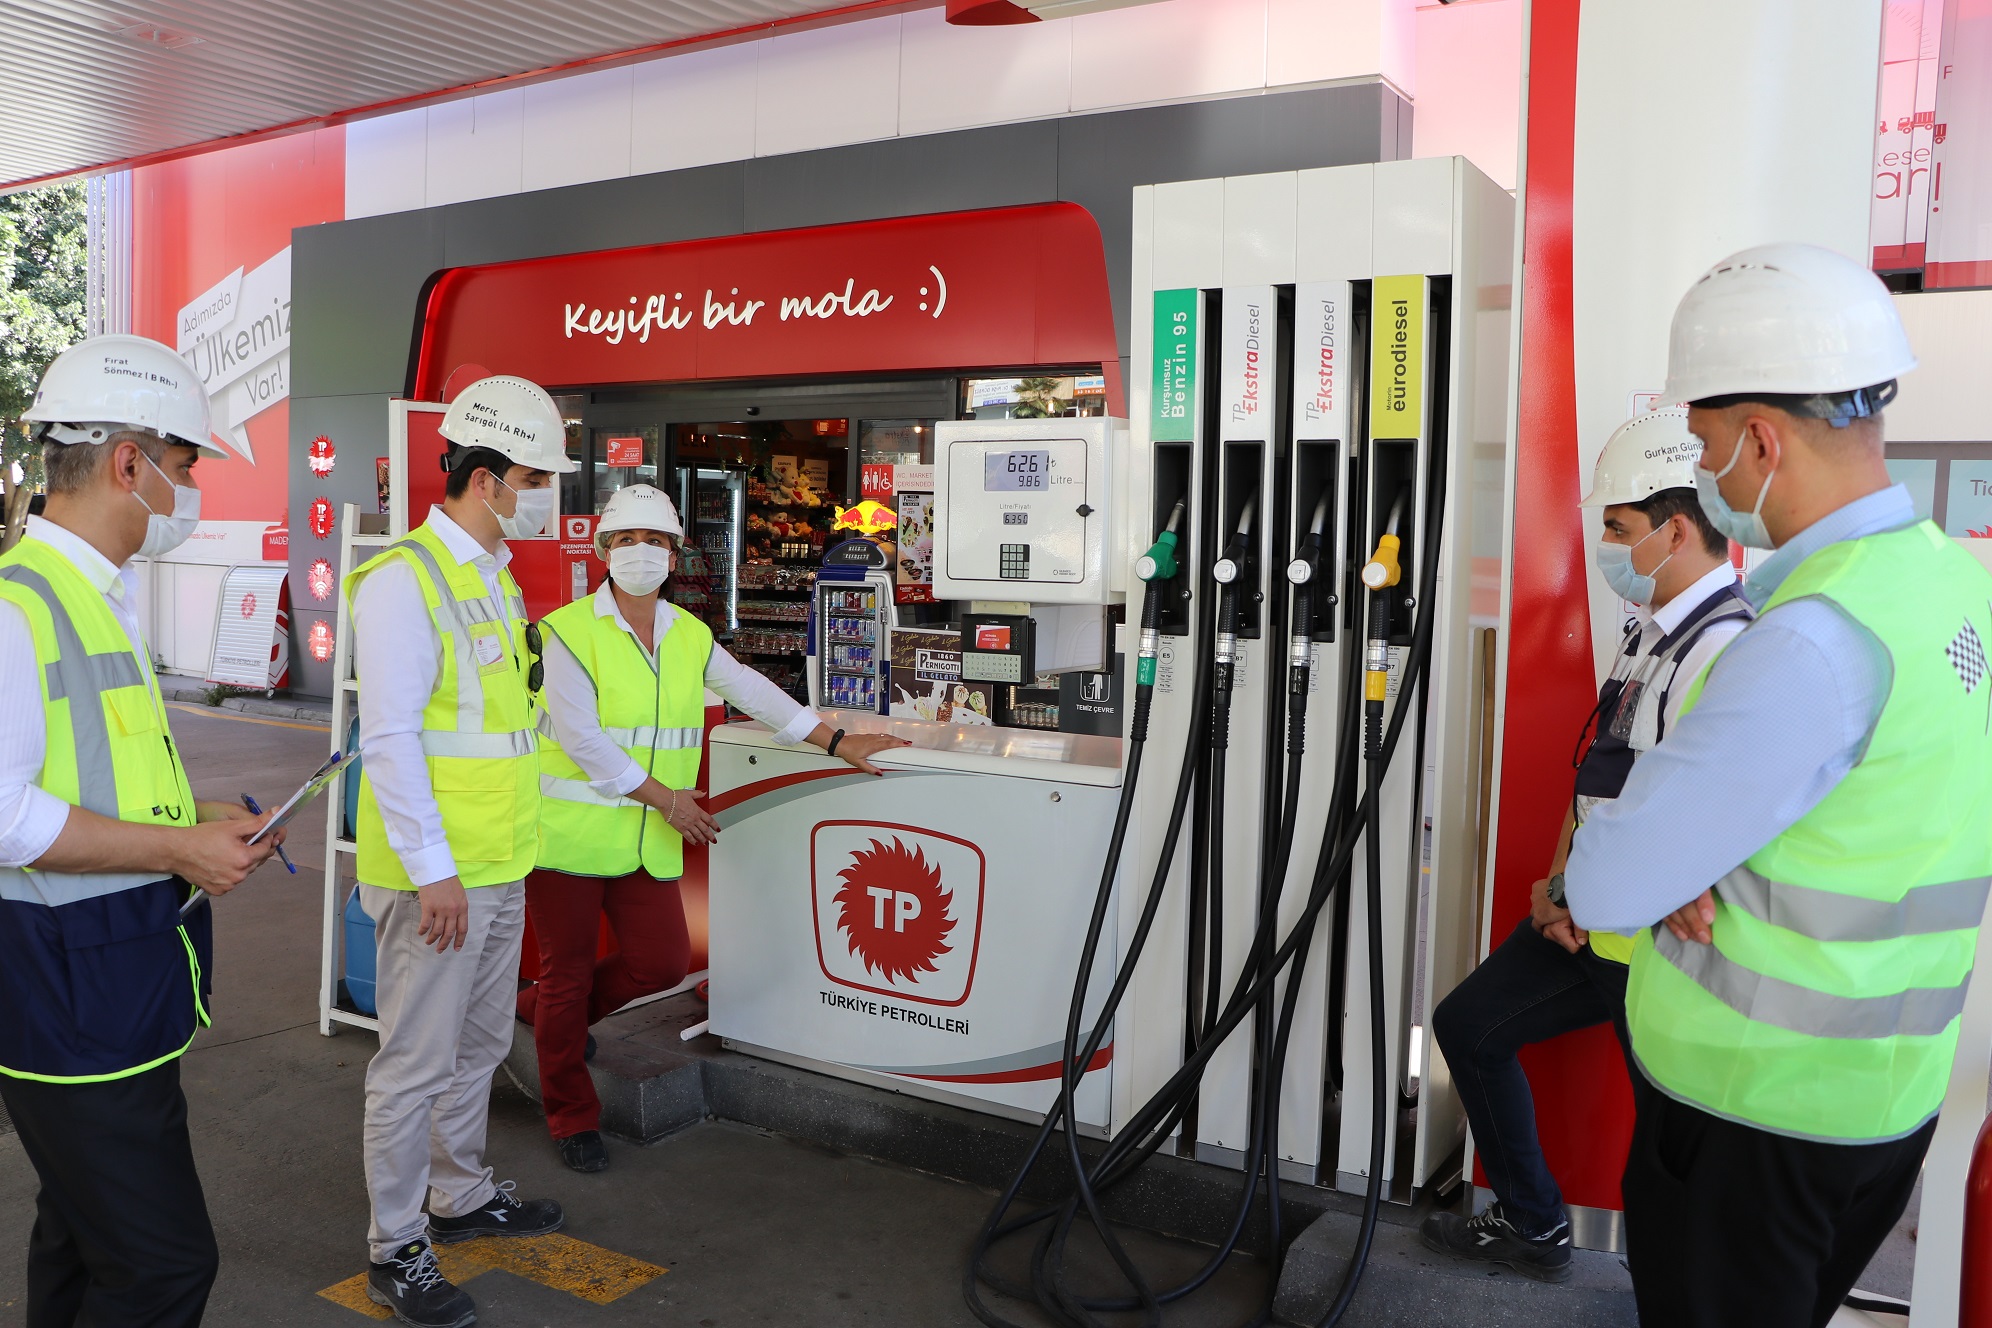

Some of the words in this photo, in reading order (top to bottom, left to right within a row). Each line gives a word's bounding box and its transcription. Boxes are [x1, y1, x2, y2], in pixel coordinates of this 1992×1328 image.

[1878, 148, 1930, 167] ese
[565, 292, 692, 344] Keyifli
[703, 287, 765, 330] bir
[779, 278, 894, 322] mola
[1173, 311, 1187, 336] 95
[192, 298, 291, 385] Ülkemiz
[1391, 300, 1408, 412] eurodiesel
[104, 366, 143, 379] Sönmez
[1171, 343, 1186, 418] Benzin
[245, 361, 283, 406] Var!
[1161, 358, 1172, 418] Kurşunsuz
[1232, 403, 1246, 423] TP
[1305, 401, 1320, 422] TP
[513, 427, 536, 442] Rh+)
[318, 442, 327, 451] TP
[1644, 445, 1679, 460] Gurkan
[1666, 456, 1673, 464] A
[1674, 452, 1699, 462] Rh(+)
[1018, 475, 1040, 487] 9.86
[1050, 475, 1073, 485] Litre
[317, 504, 326, 514] TP
[316, 627, 326, 636] TP
[930, 672, 958, 681] GELATO
[866, 885, 922, 933] TP
[820, 990, 877, 1016] TÜRKİYE
[881, 1005, 969, 1035] PETROLLERİ
